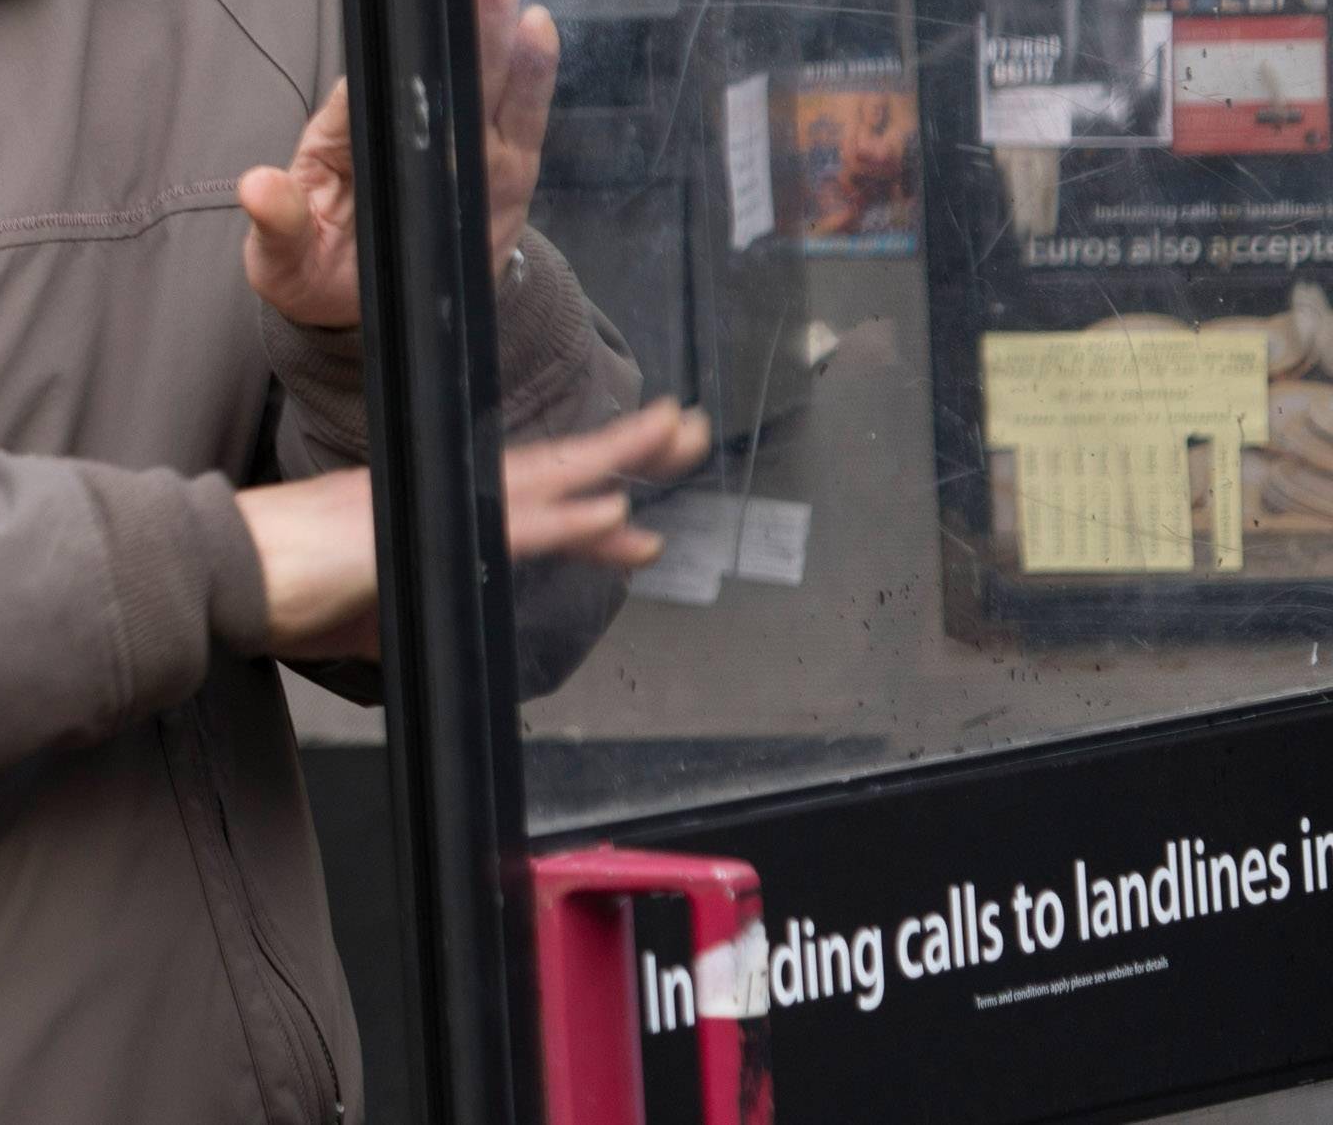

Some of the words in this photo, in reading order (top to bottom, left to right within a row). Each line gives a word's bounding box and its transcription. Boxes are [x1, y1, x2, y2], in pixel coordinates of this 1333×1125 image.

[1094, 202, 1178, 225] Including
[1182, 202, 1218, 218] calls
[1028, 234, 1122, 266] Euros
[1129, 225, 1202, 264] also
[642, 916, 885, 1035] Inding
[896, 882, 1004, 980] calls
[1012, 883, 1065, 954] to
[1075, 837, 1291, 942] landlines
[975, 994, 999, 1010] Terms
[998, 990, 1013, 1005] and
[1013, 984, 1050, 1002] conditions
[1050, 978, 1071, 995] apply
[1070, 974, 1094, 992] please
[1094, 972, 1106, 984] see
[1106, 964, 1134, 981] website
[1134, 961, 1145, 974] for
[1145, 955, 1169, 973] details
